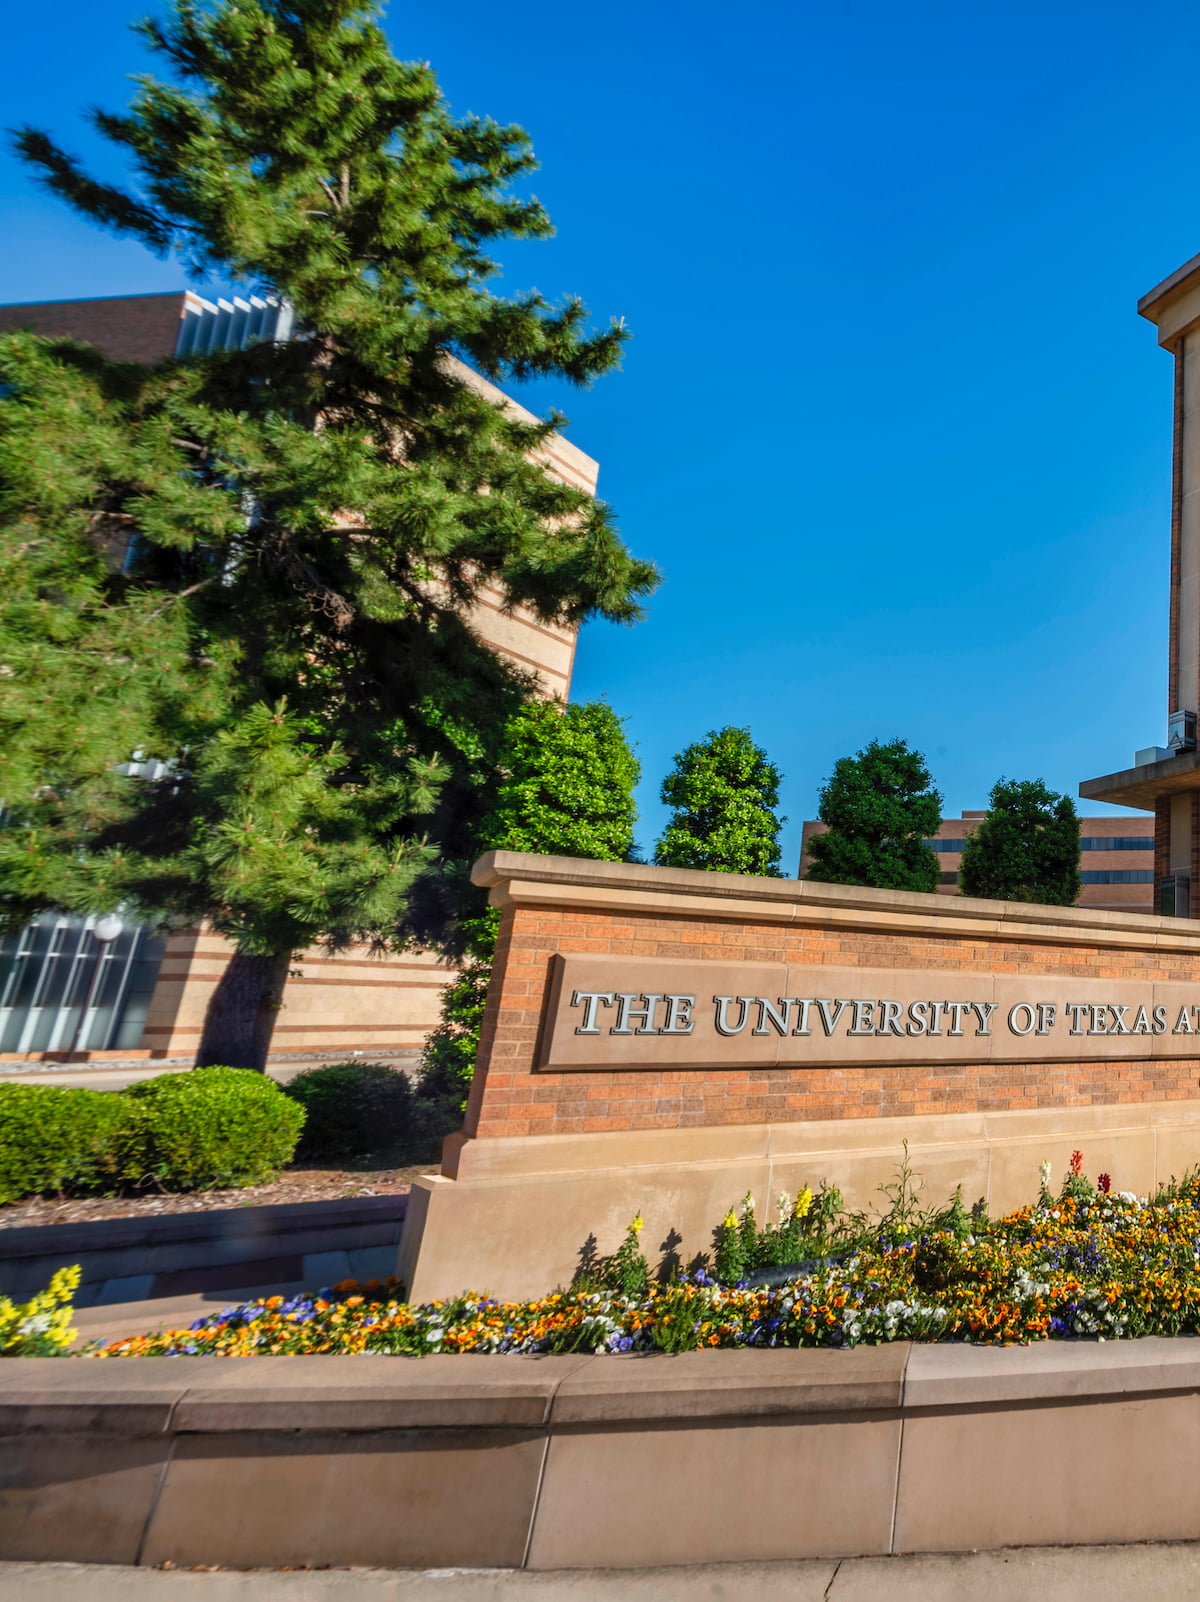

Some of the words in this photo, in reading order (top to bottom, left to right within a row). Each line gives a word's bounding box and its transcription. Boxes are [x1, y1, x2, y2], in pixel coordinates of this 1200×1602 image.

[572, 990, 697, 1036] THE
[712, 995, 998, 1037] UNIVERSITY
[1007, 1003, 1057, 1036] OF
[1065, 1003, 1168, 1036] TEXAS
